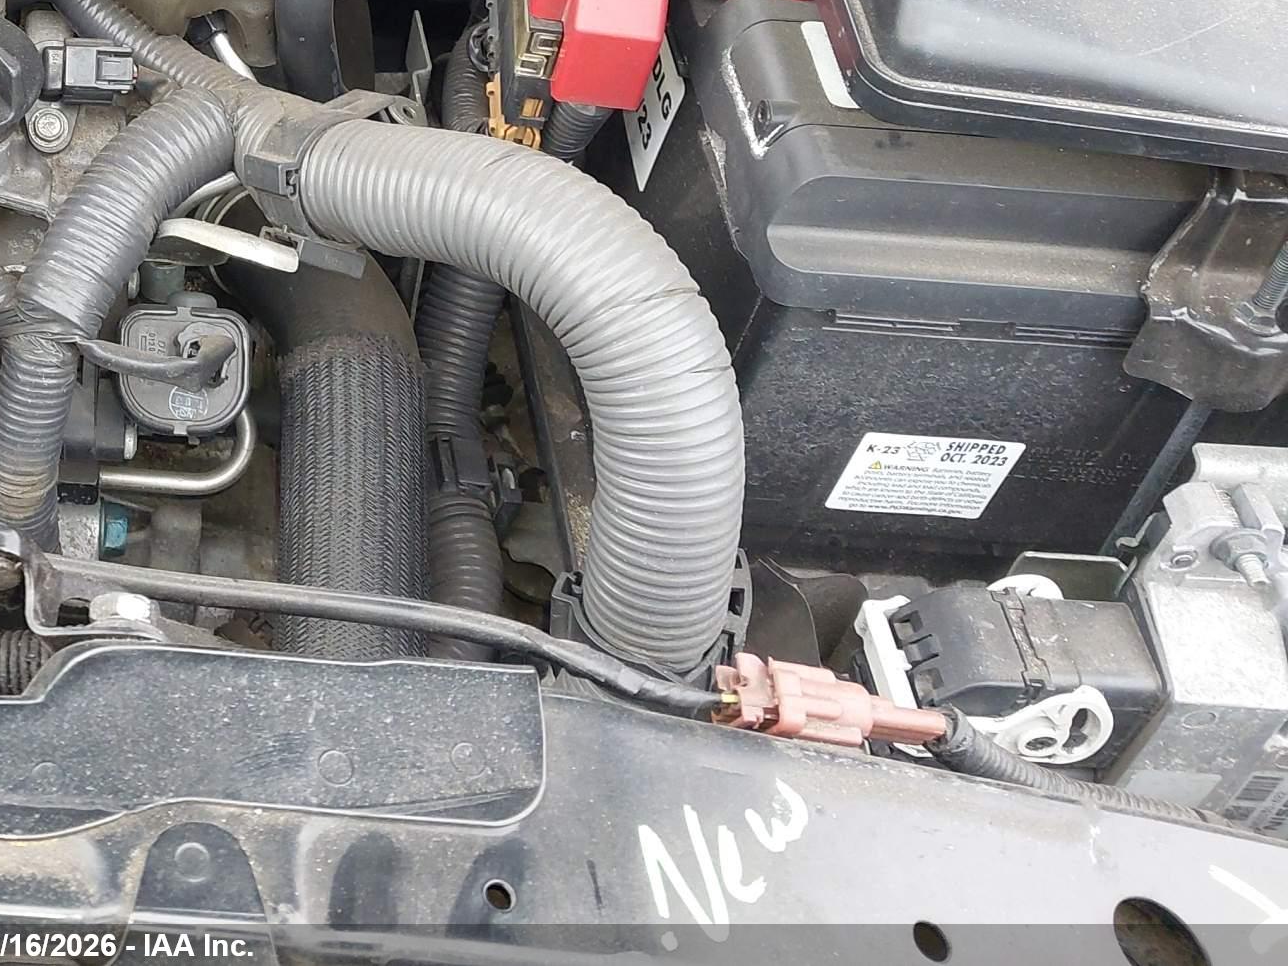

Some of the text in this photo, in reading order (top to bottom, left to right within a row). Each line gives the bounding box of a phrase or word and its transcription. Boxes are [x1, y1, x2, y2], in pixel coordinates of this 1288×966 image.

[866, 444, 901, 455] K-23
[946, 441, 1006, 455] SHIPPED
[940, 452, 1008, 467] OCT. 2023
[638, 777, 808, 943] New
